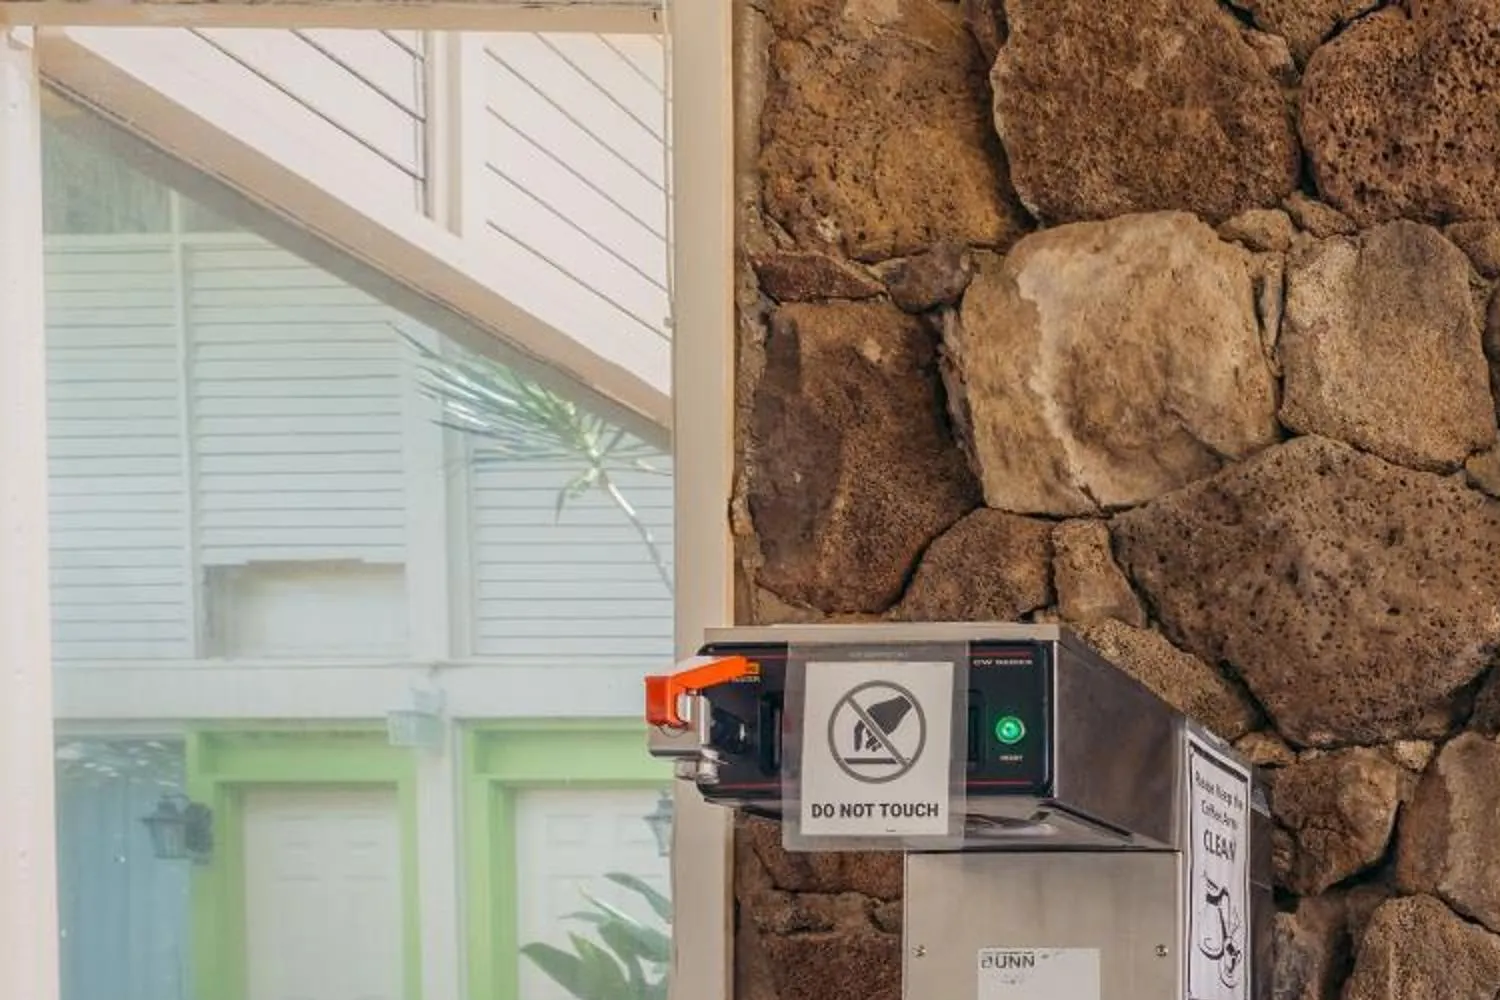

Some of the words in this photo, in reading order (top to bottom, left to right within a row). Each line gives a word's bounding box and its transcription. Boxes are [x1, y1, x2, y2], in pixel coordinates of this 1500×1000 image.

[811, 803, 835, 818] DO
[840, 803, 875, 818] NOT
[879, 803, 938, 818] TOUCH
[1203, 829, 1237, 863] CLEAN
